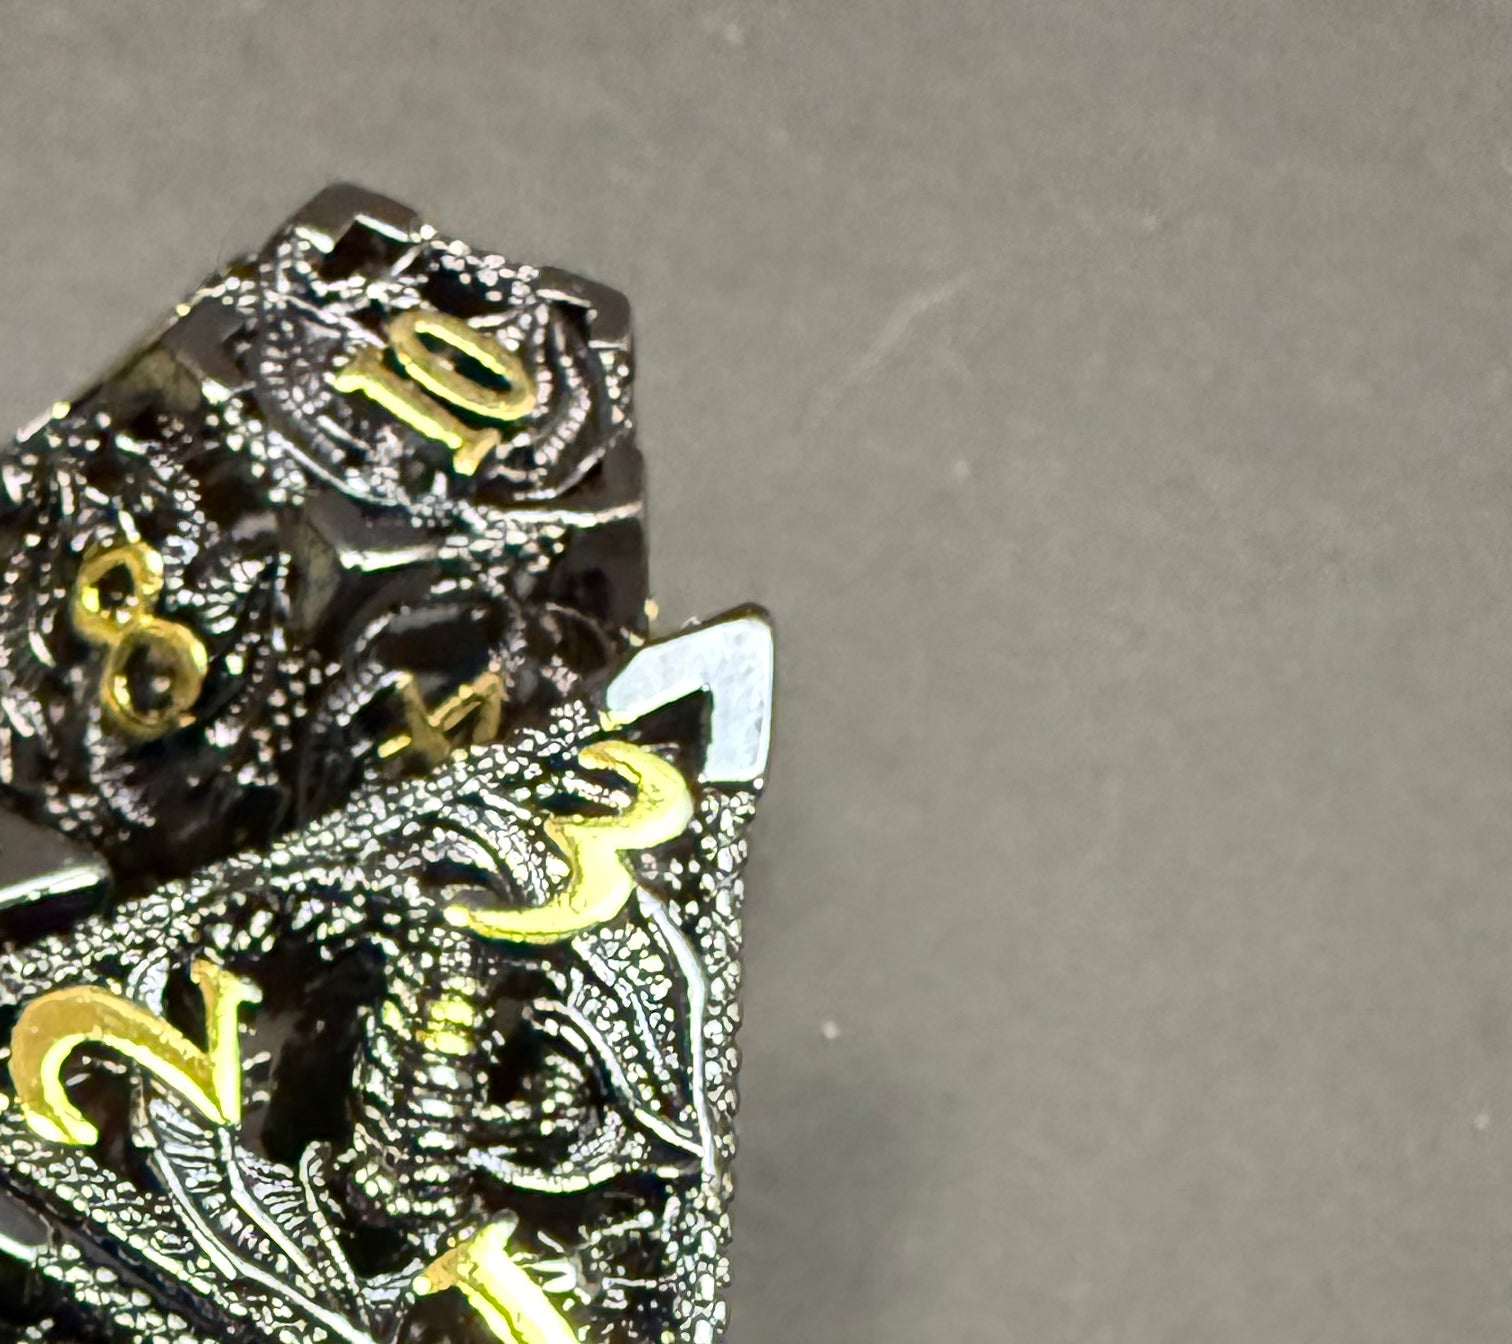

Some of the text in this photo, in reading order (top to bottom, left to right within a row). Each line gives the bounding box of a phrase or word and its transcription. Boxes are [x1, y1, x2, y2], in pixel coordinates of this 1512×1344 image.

[333, 308, 535, 476] 10
[71, 538, 208, 738] 8
[444, 740, 694, 944] 3
[9, 957, 263, 1147] 2
